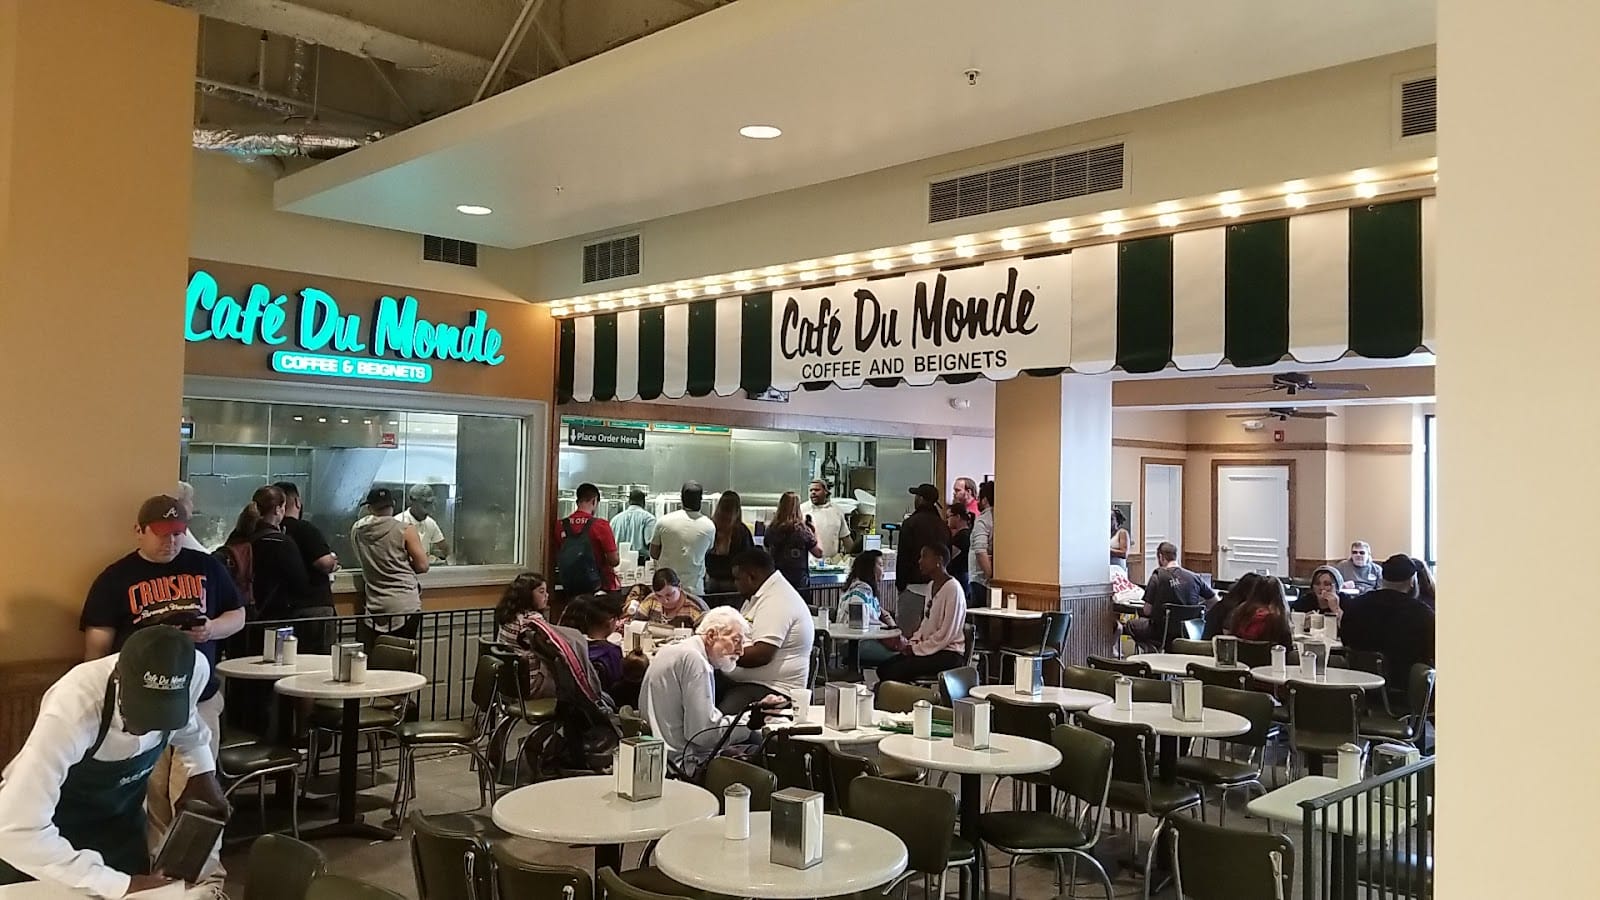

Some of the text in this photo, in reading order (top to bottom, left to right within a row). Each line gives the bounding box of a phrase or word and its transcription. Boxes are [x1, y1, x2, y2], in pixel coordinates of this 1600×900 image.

[184, 270, 505, 366] Café Du Monde
[780, 267, 1039, 360] Café Du Monde
[281, 355, 426, 380] COFFEE & BEIGNETS
[802, 350, 1007, 379] COFFEE AND BEIGNETS
[577, 432, 638, 444] Place Order Here
[163, 507, 178, 518] A
